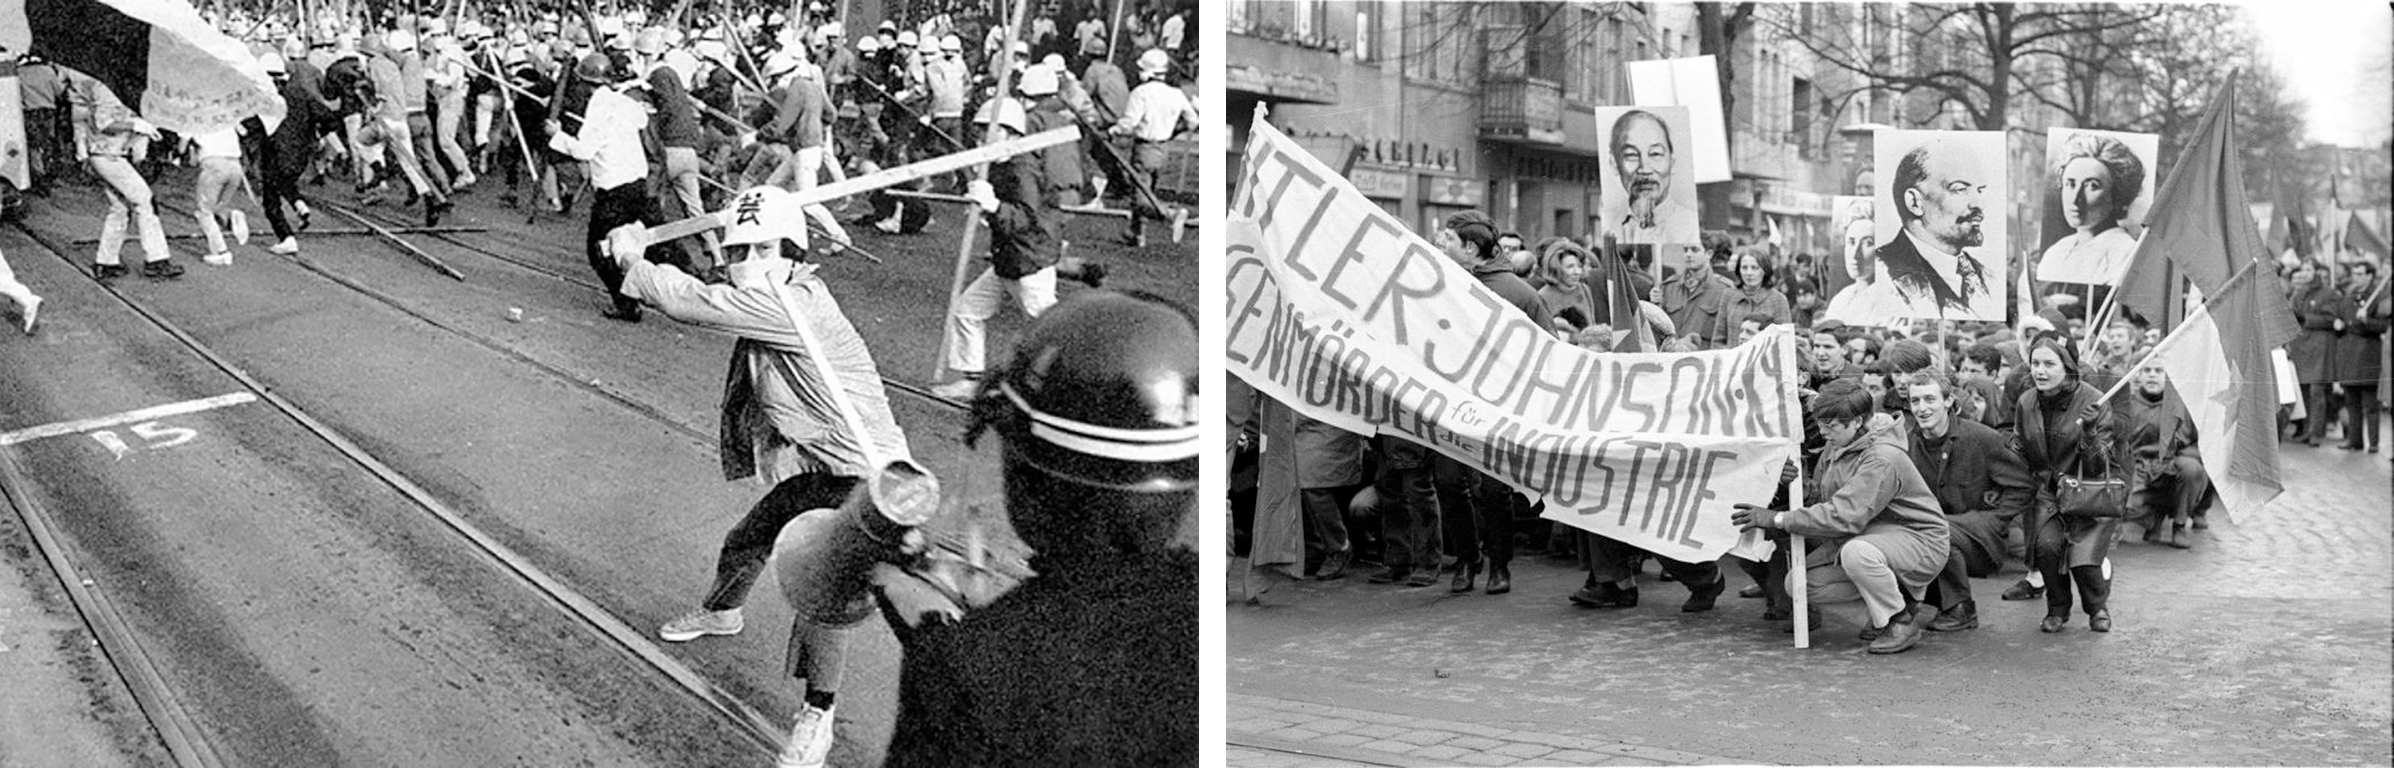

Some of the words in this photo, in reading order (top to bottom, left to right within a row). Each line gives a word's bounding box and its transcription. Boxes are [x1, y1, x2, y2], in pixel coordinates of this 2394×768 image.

[1451, 400, 1487, 427] für
[1439, 431, 1473, 453] die
[1482, 417, 1738, 549] INDUSTRIE
